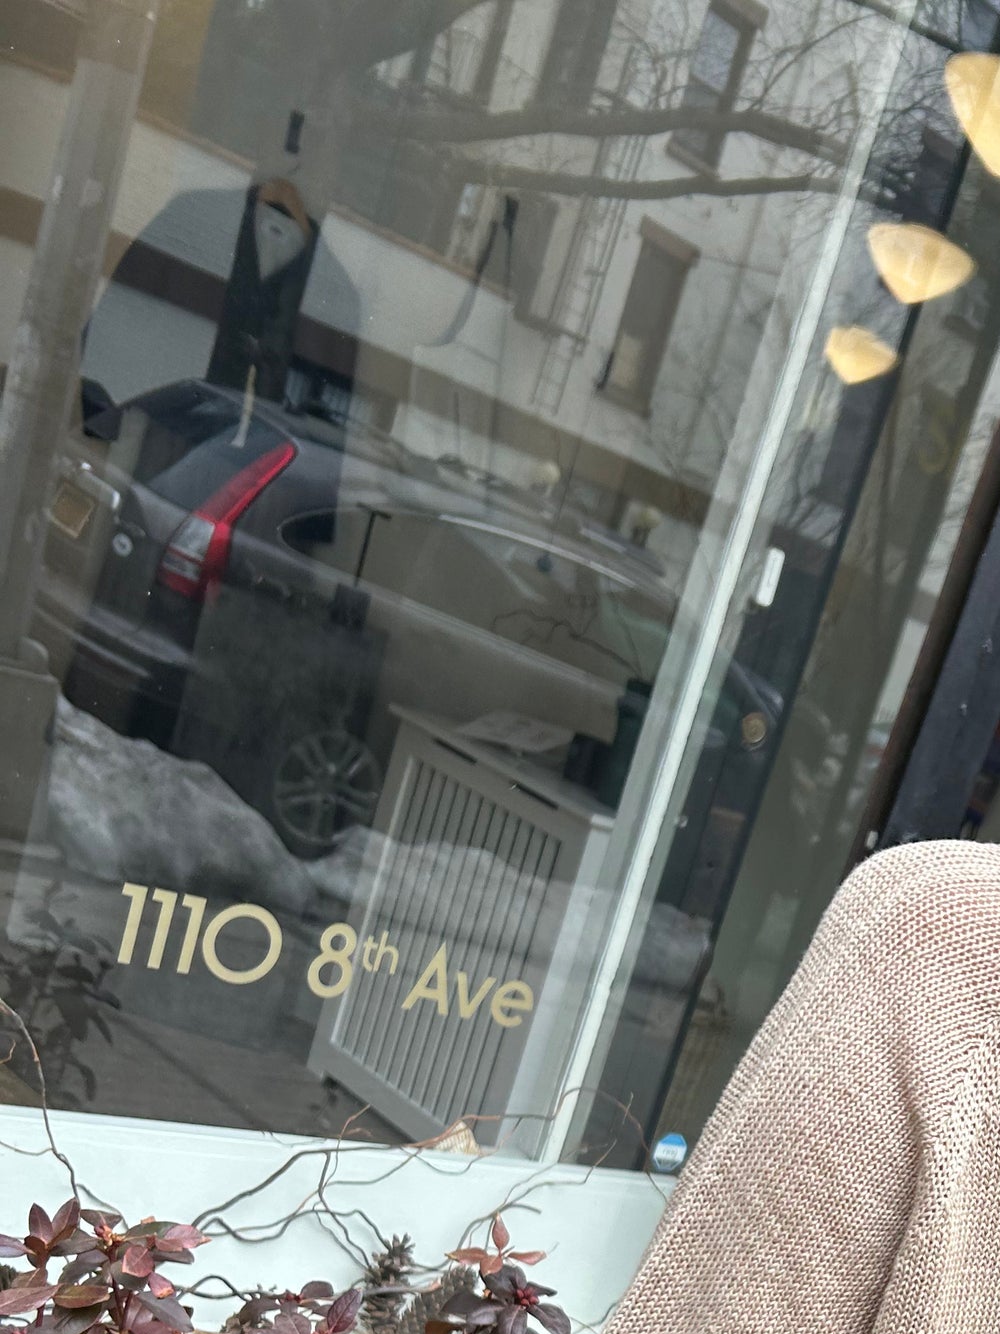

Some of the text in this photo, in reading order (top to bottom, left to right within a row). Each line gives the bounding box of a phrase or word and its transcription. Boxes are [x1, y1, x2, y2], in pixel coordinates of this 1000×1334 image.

[117, 882, 534, 1028] 1110 8th Ave
